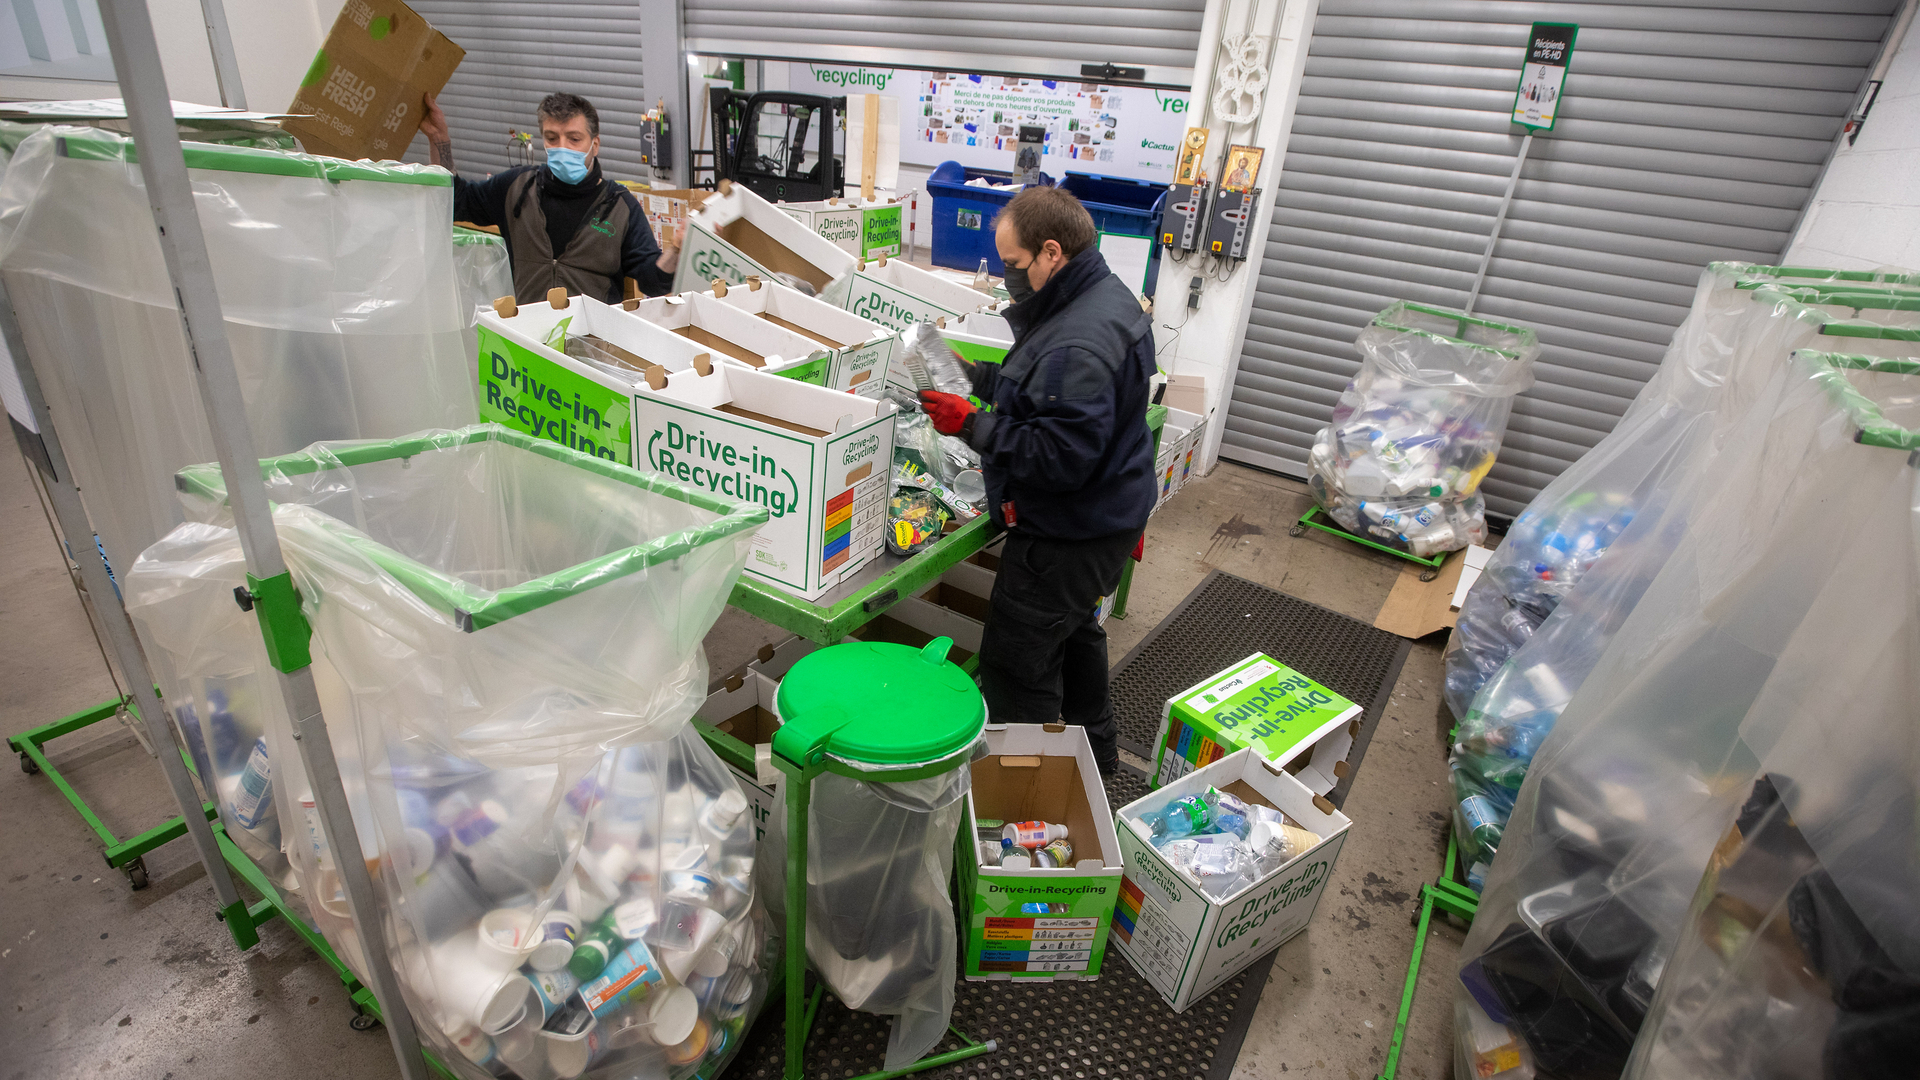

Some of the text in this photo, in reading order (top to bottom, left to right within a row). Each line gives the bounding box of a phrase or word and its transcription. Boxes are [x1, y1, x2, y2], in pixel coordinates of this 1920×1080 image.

[1534, 38, 1566, 50] Récipients
[1533, 48, 1562, 60] en PE-HD
[330, 65, 376, 101] HELLO
[817, 68, 886, 90] recycling
[321, 80, 369, 118] FRESH
[954, 90, 972, 98] Merci
[1005, 94, 1033, 104] déposer
[1047, 98, 1076, 107] produits
[963, 99, 985, 107] dehors
[315, 108, 331, 124] Est
[1148, 141, 1175, 151] Cactus
[824, 217, 854, 229] Drive-in
[869, 215, 899, 229] Drive-in-
[821, 228, 856, 242] Recycling
[867, 229, 899, 243] Recycling
[850, 356, 877, 371] Recycling
[855, 350, 877, 363] Drive-in
[491, 351, 611, 430] Drive-in-
[667, 421, 776, 479] Drive-in
[849, 434, 876, 453] Drive-in
[845, 443, 877, 465] Recycling
[659, 448, 785, 518] Recycling
[1219, 680, 1239, 692] Cactus
[1213, 675, 1311, 730] Recycling
[1250, 690, 1333, 740] Drive-in-
[1136, 857, 1178, 901] Recycling
[1141, 852, 1176, 890] Drive-in
[989, 885, 1107, 896] Drive-in-Recycling
[1239, 861, 1319, 921] Drive-in
[1223, 876, 1318, 947] Recycling
